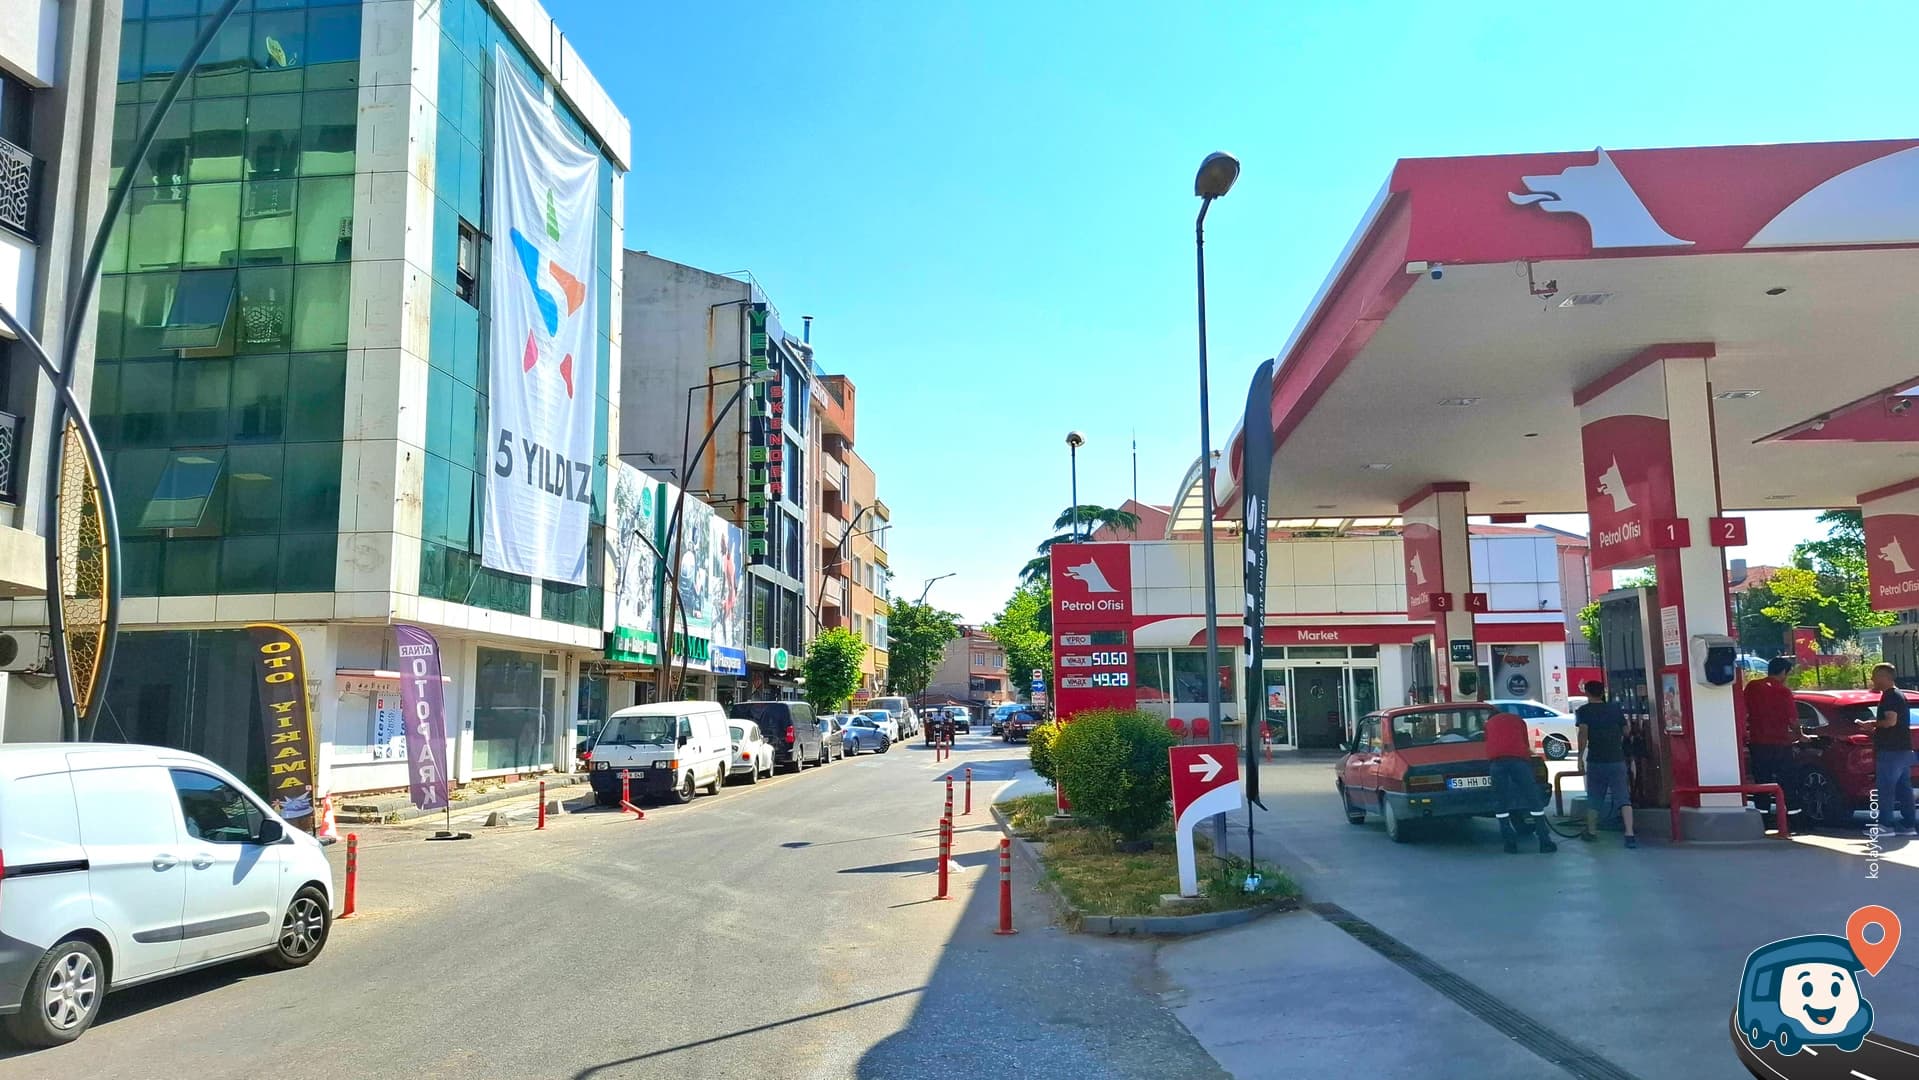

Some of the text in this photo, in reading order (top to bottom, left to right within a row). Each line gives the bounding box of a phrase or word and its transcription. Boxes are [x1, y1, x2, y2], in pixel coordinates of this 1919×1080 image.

[495, 428, 513, 478] 5
[522, 437, 591, 504] YILDIZ
[1600, 520, 1641, 548] Petrol Ofisi
[1667, 524, 1675, 541] 1
[1724, 523, 1736, 539] 2
[1880, 583, 1901, 596] Petrol
[1061, 600, 1124, 611] Petrol Ofisi
[1438, 597, 1446, 607] 3
[1473, 596, 1480, 606] 4
[1297, 630, 1339, 641] Market
[1092, 652, 1127, 666] 50.60
[1093, 673, 1129, 687] 49.28
[376, 710, 385, 759] Sistem
[1453, 779, 1463, 787] 59
[1467, 778, 1478, 786] HH
